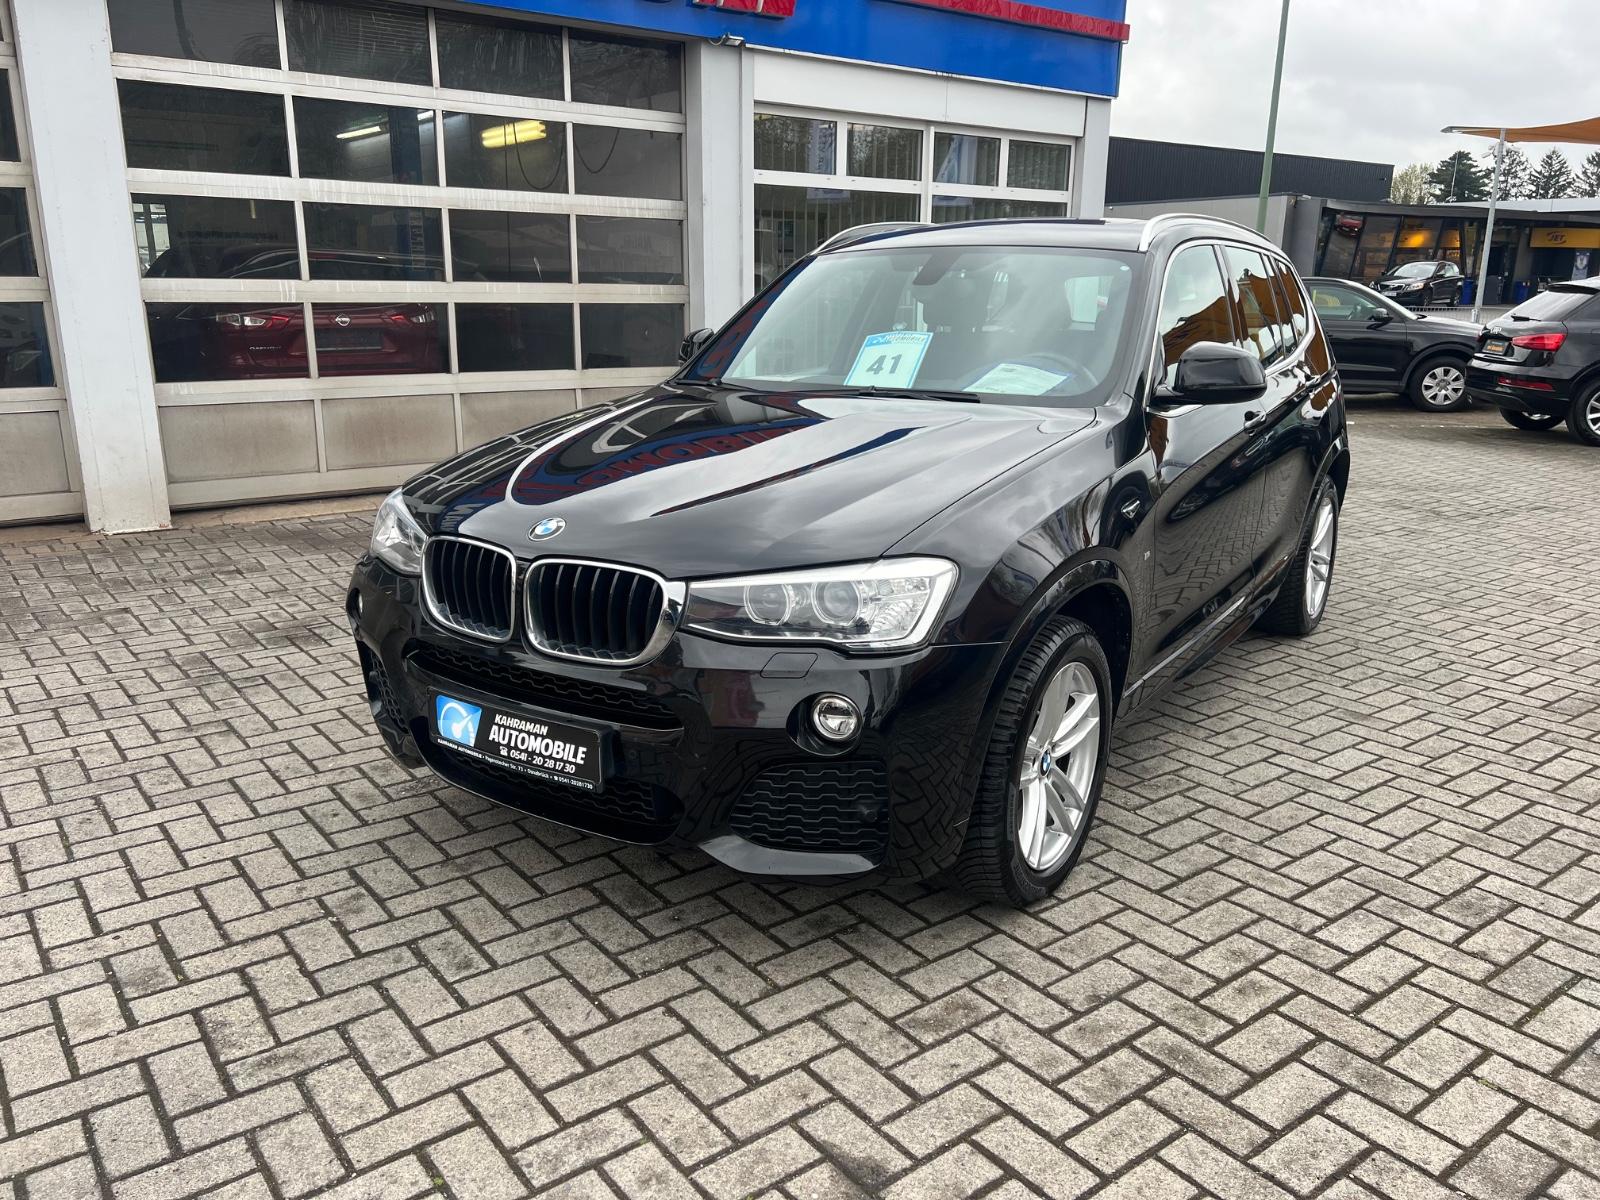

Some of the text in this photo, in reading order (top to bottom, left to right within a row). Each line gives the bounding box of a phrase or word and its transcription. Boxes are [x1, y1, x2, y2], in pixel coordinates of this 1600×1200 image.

[866, 354, 902, 375] 41
[494, 713, 548, 736] KAHRAMAN
[488, 724, 587, 765] AUTOMOBILE
[510, 749, 528, 762] 0541
[532, 755, 544, 765] 20
[544, 758, 555, 768] 28
[555, 761, 564, 770] 17
[564, 763, 576, 773] 30
